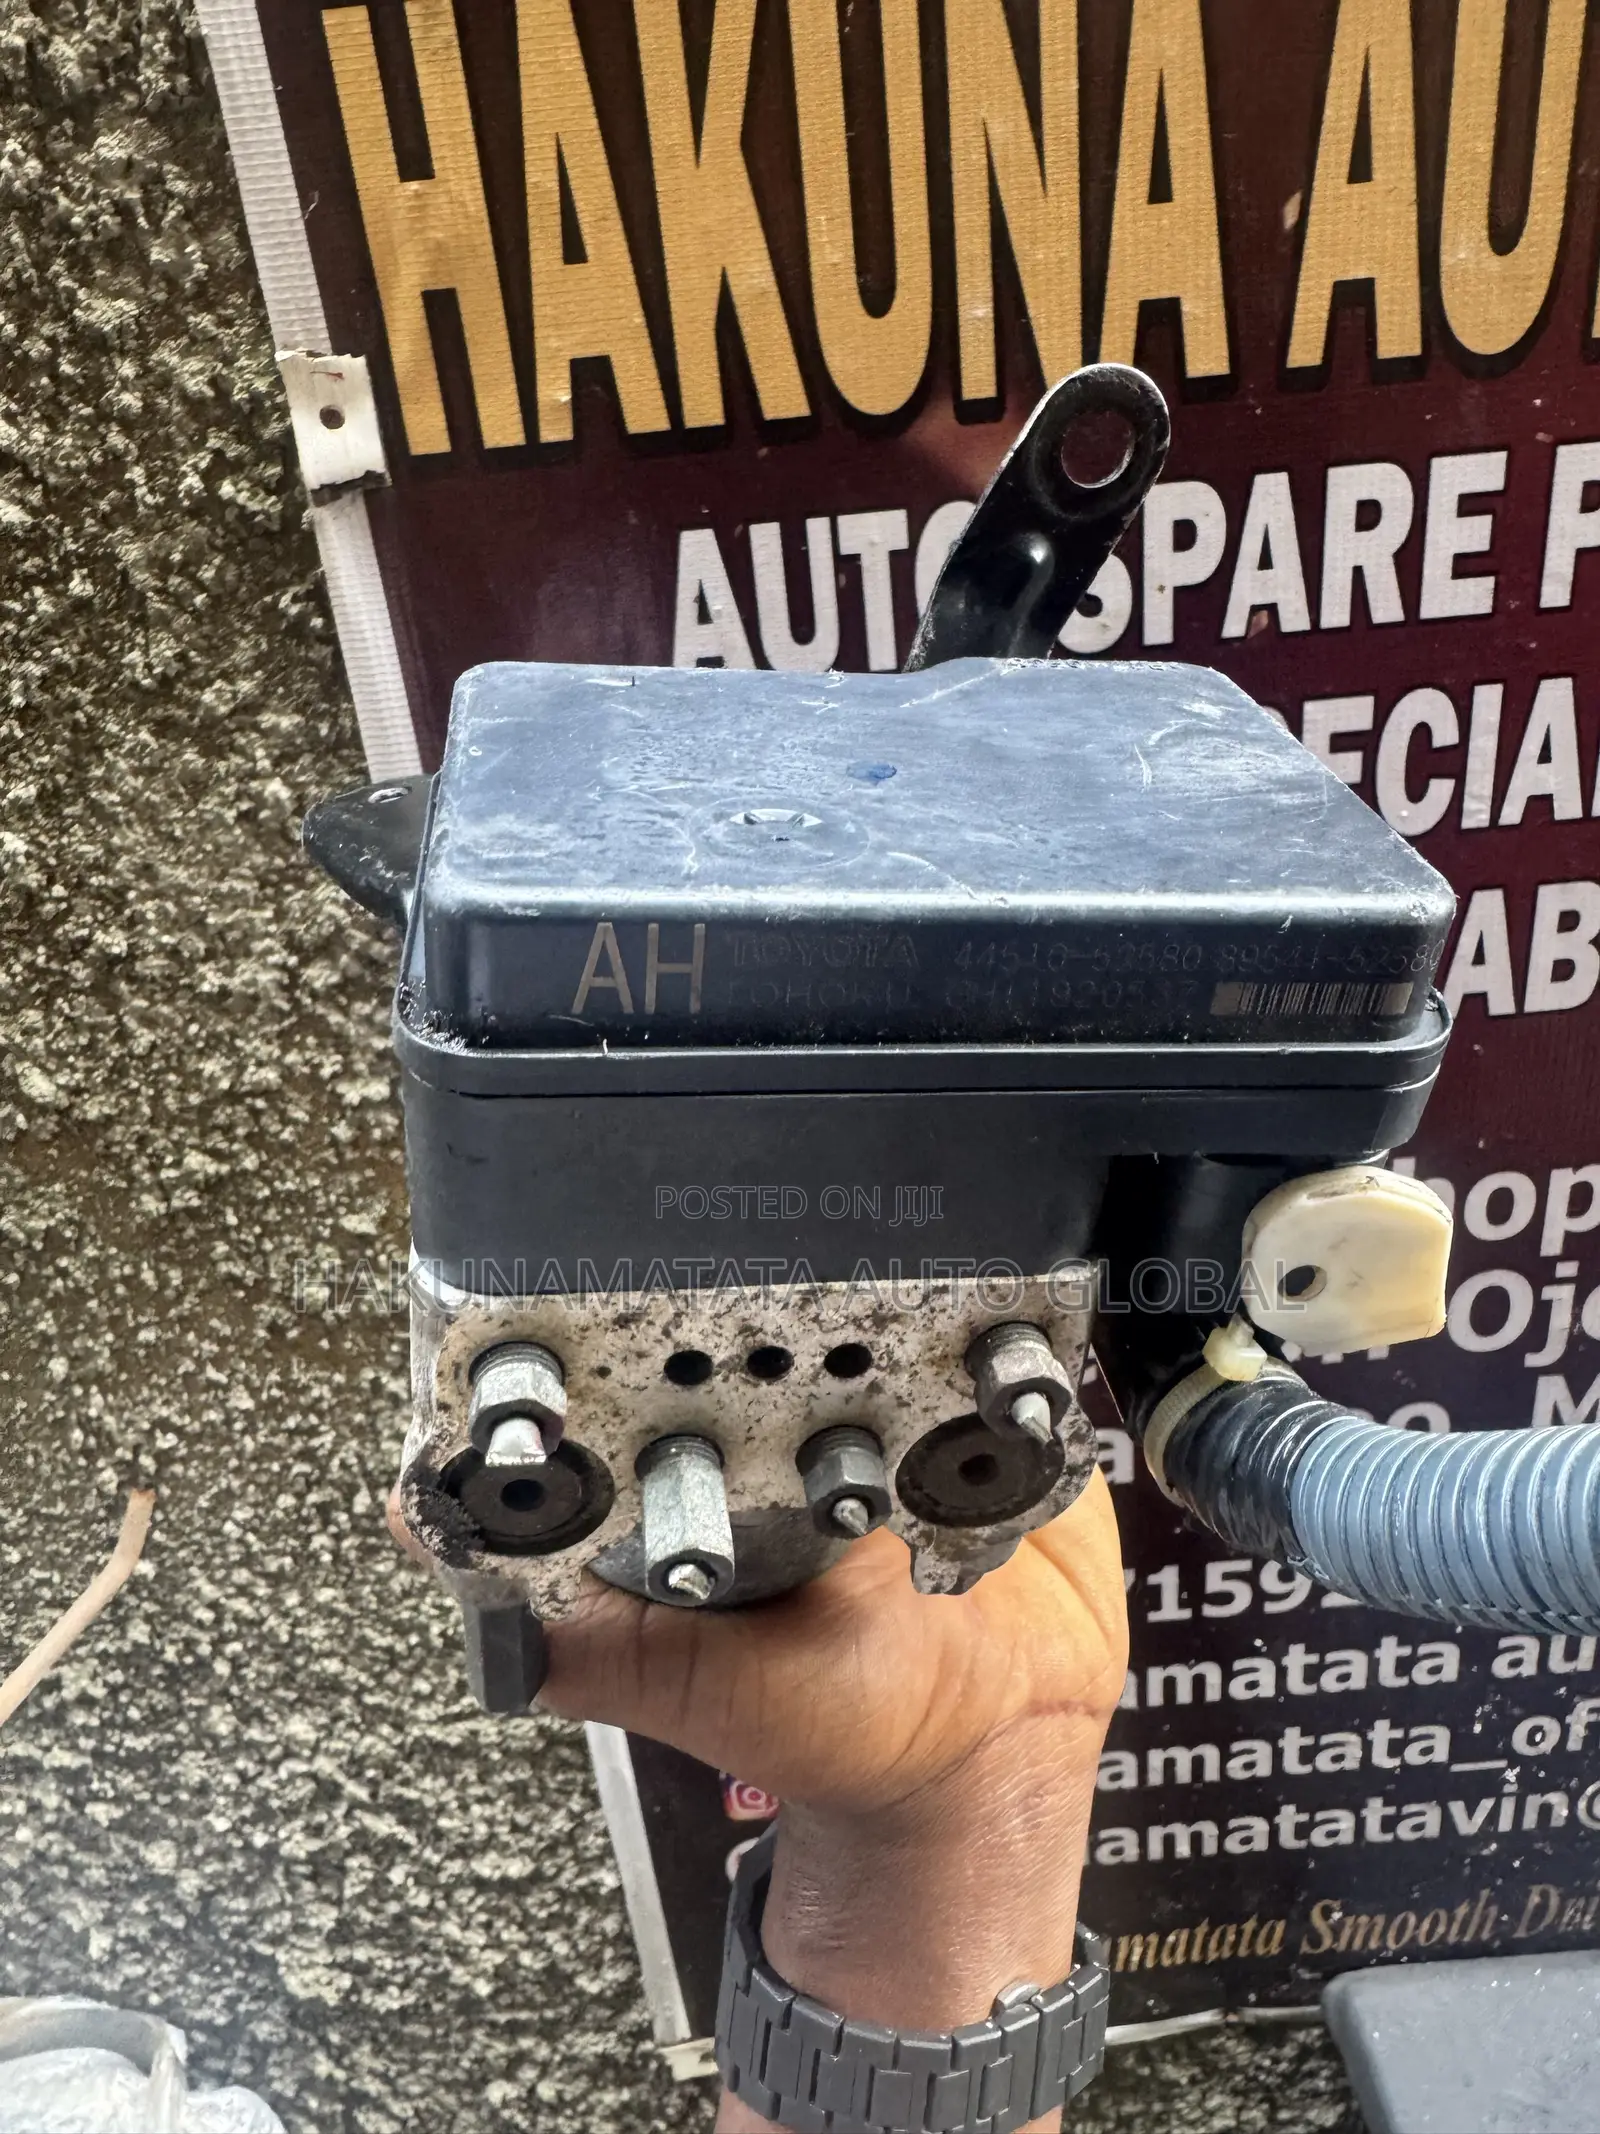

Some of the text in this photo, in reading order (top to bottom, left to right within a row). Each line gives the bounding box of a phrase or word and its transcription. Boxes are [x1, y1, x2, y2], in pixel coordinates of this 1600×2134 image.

[322, 0, 1600, 456] HAKUNA AU
[1266, 677, 1600, 837] ECIA
[571, 921, 706, 1014] AH
[1447, 1260, 1600, 1368] Oj
[1122, 1558, 1364, 1623] 159
[1101, 1913, 1286, 1973] matata
[1300, 1888, 1498, 1955] Smooth
